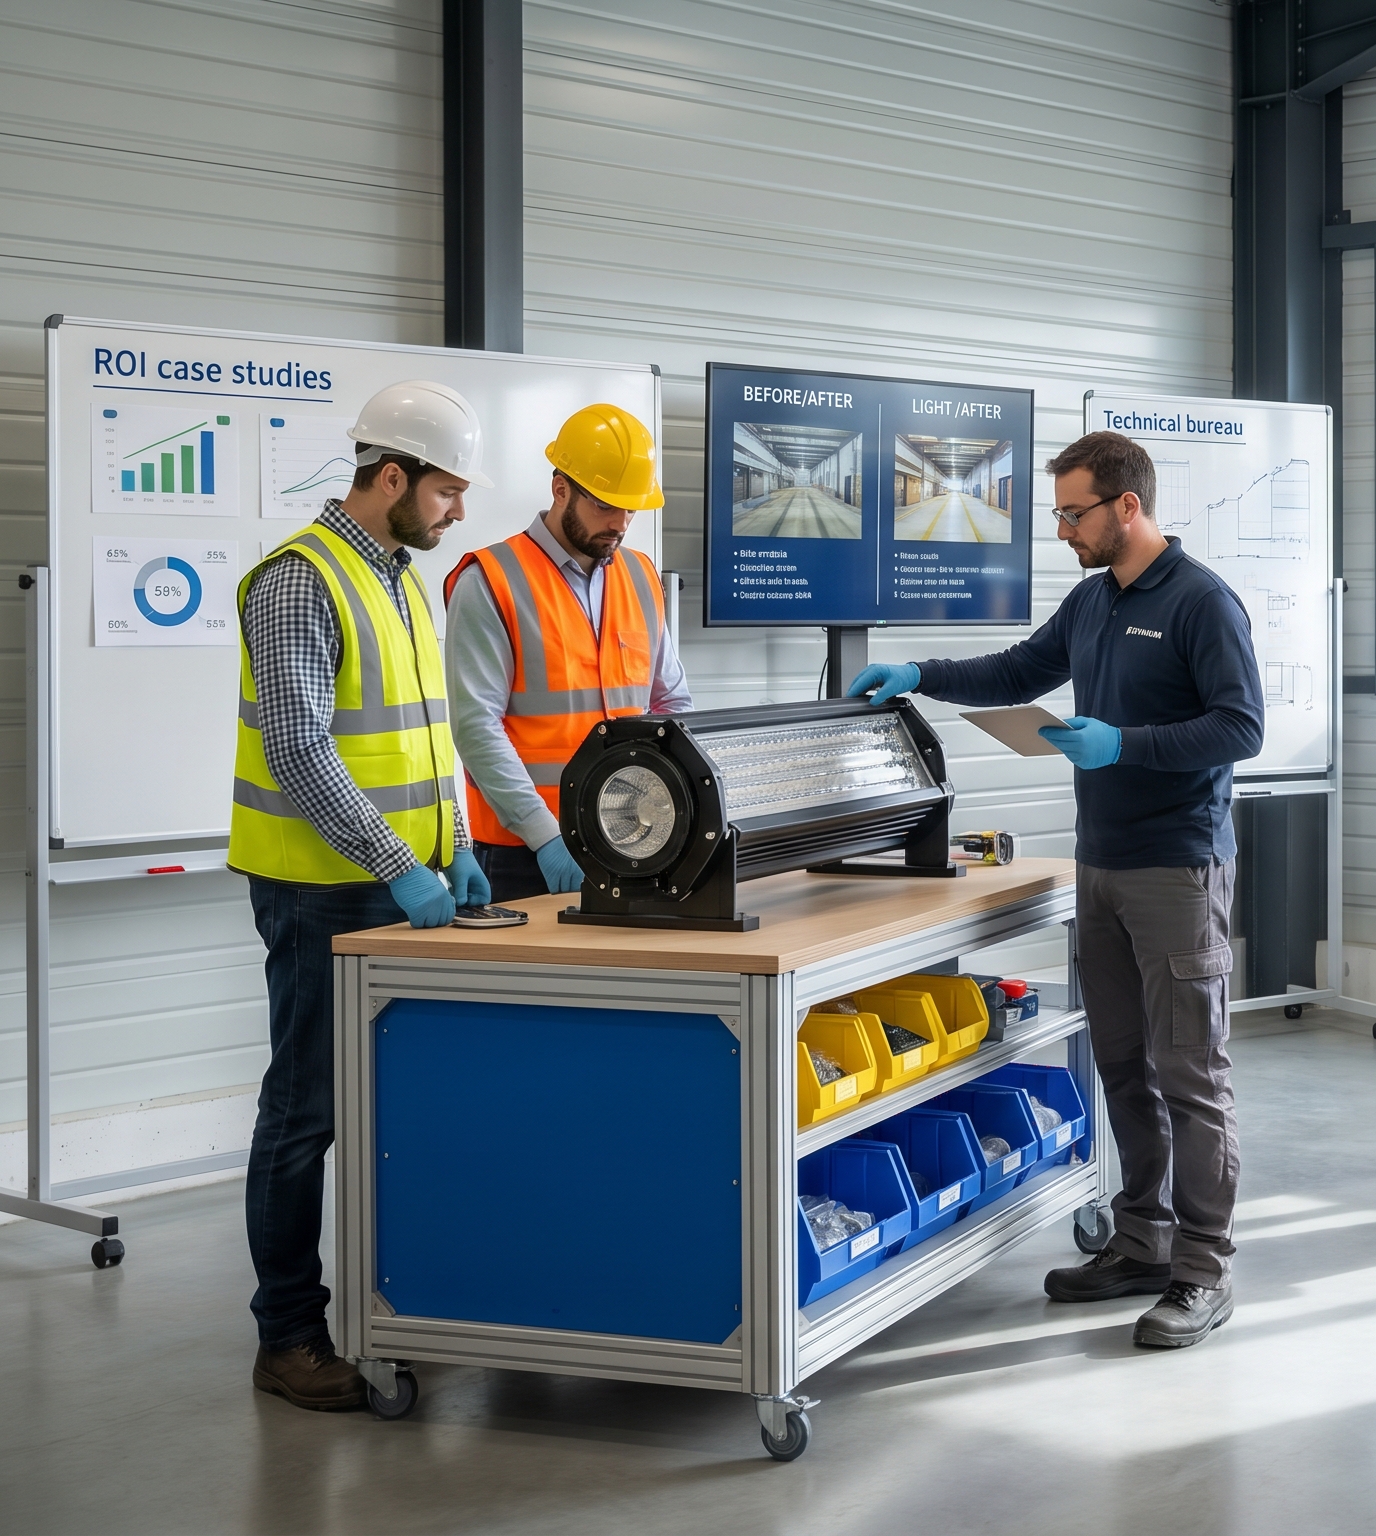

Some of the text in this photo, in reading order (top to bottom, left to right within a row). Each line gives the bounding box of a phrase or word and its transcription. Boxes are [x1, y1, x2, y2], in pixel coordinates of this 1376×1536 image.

[94, 348, 332, 390] ROI case studies
[743, 385, 853, 409] BEFORE/AFTER
[912, 398, 1002, 420] LIGHT /AFTER
[1103, 410, 1243, 435] Technical bureau
